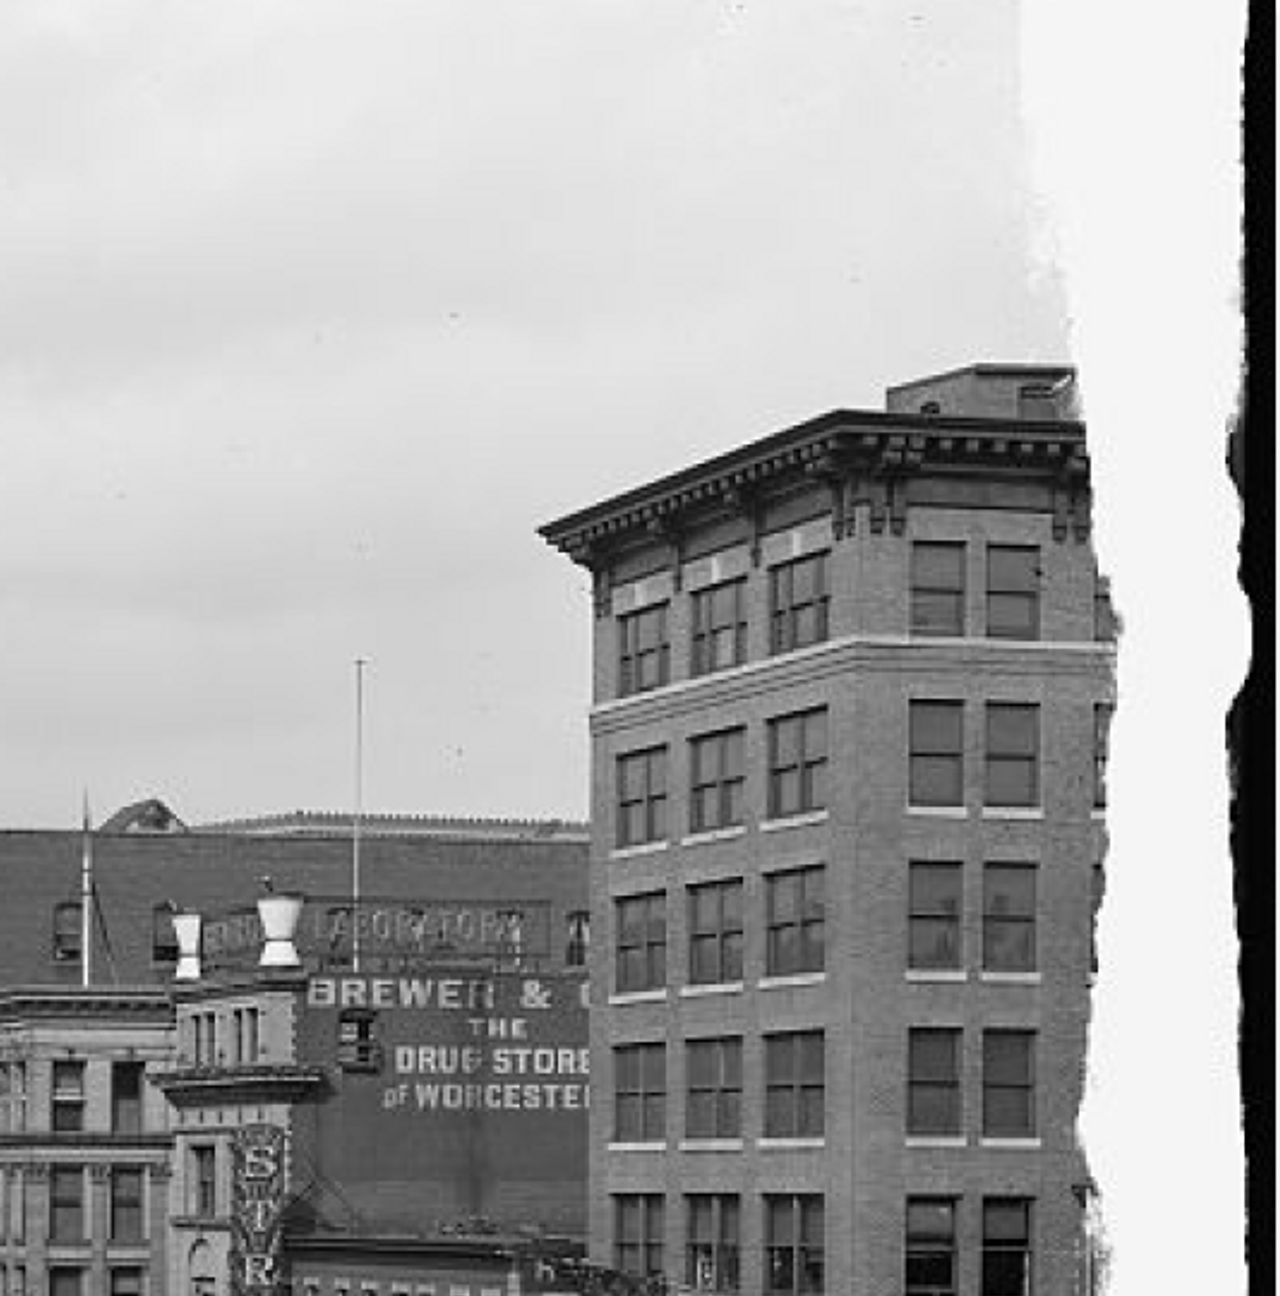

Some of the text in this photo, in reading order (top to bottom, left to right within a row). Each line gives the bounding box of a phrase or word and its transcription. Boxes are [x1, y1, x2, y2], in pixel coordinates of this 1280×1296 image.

[306, 978, 494, 1008] BREWER
[520, 978, 552, 1008] &
[468, 1018, 527, 1039] THE
[395, 1045, 482, 1074] DRUG
[415, 1084, 590, 1108] WORCESTE
